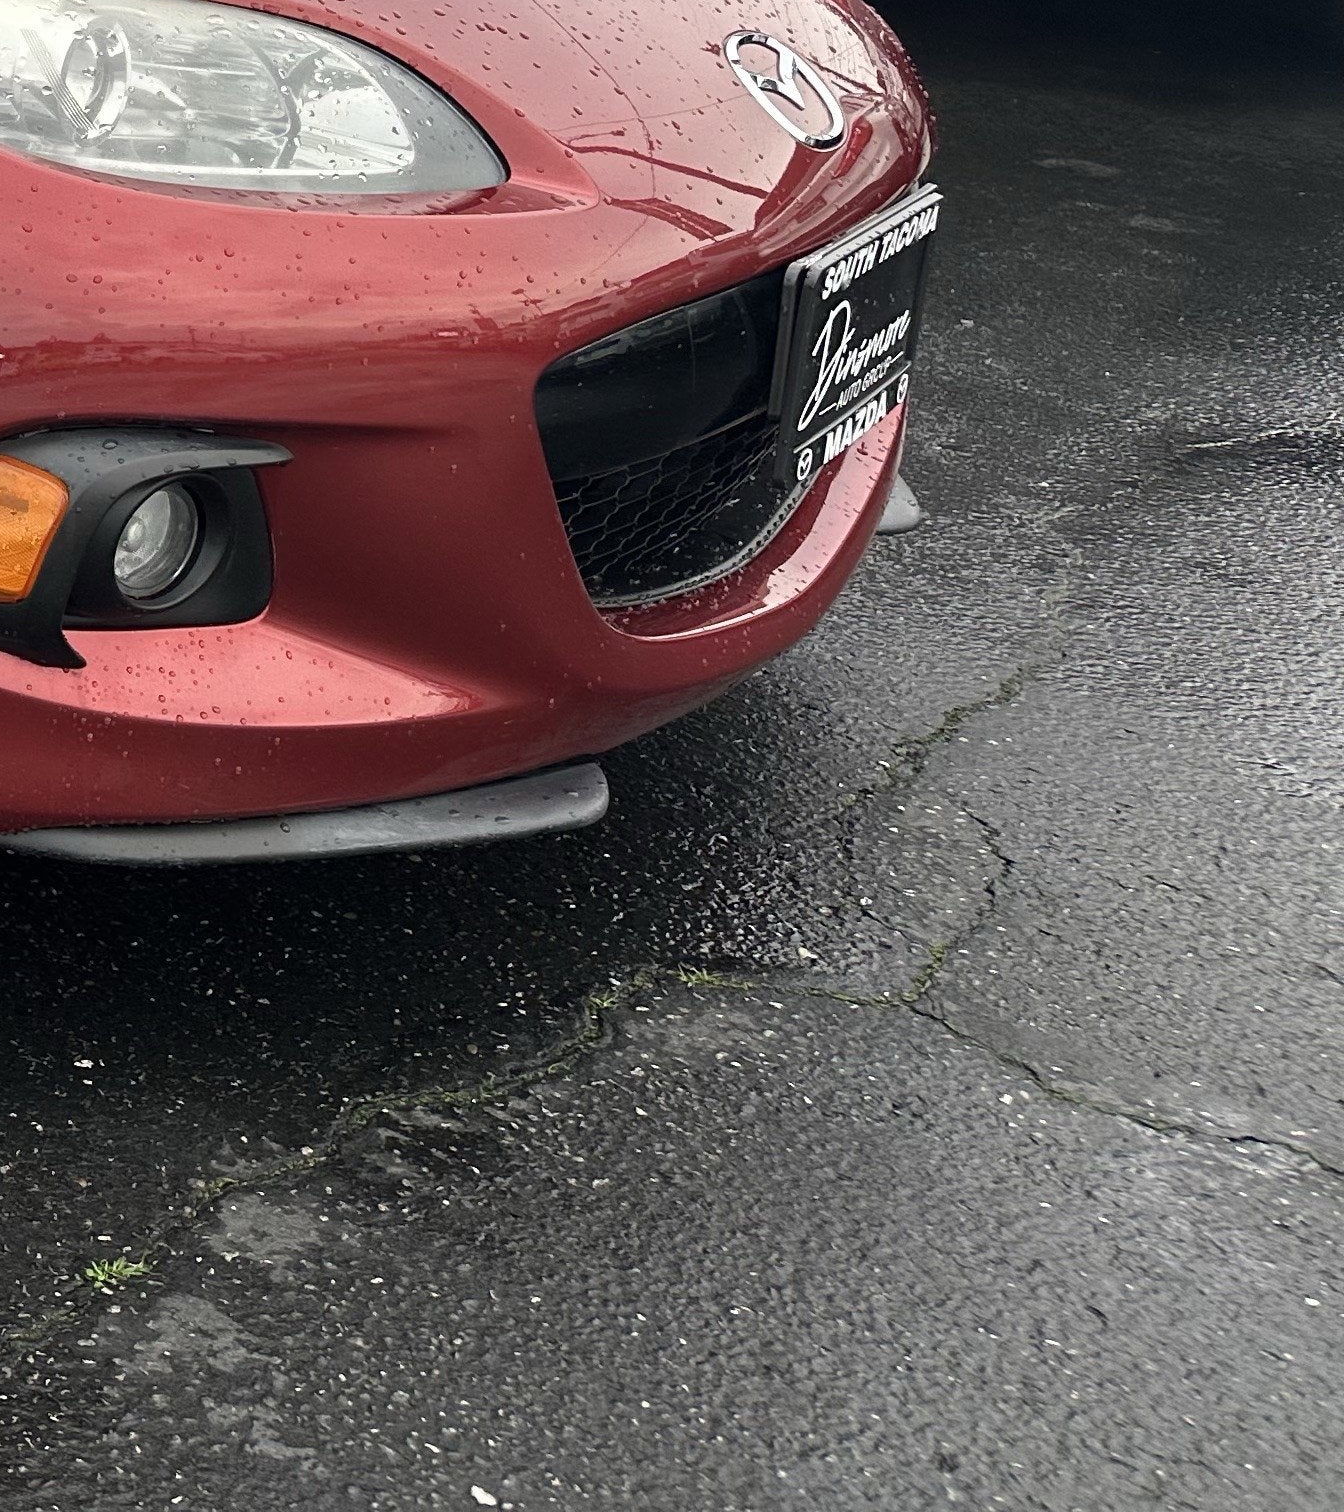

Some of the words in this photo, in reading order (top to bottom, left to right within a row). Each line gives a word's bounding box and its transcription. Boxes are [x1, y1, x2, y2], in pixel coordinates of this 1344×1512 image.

[822, 241, 879, 300] SOUTH
[879, 205, 940, 264] TACOMA
[797, 300, 911, 431] Dinsmore
[835, 379, 862, 411] AUTO
[823, 390, 888, 464] MAZDA
